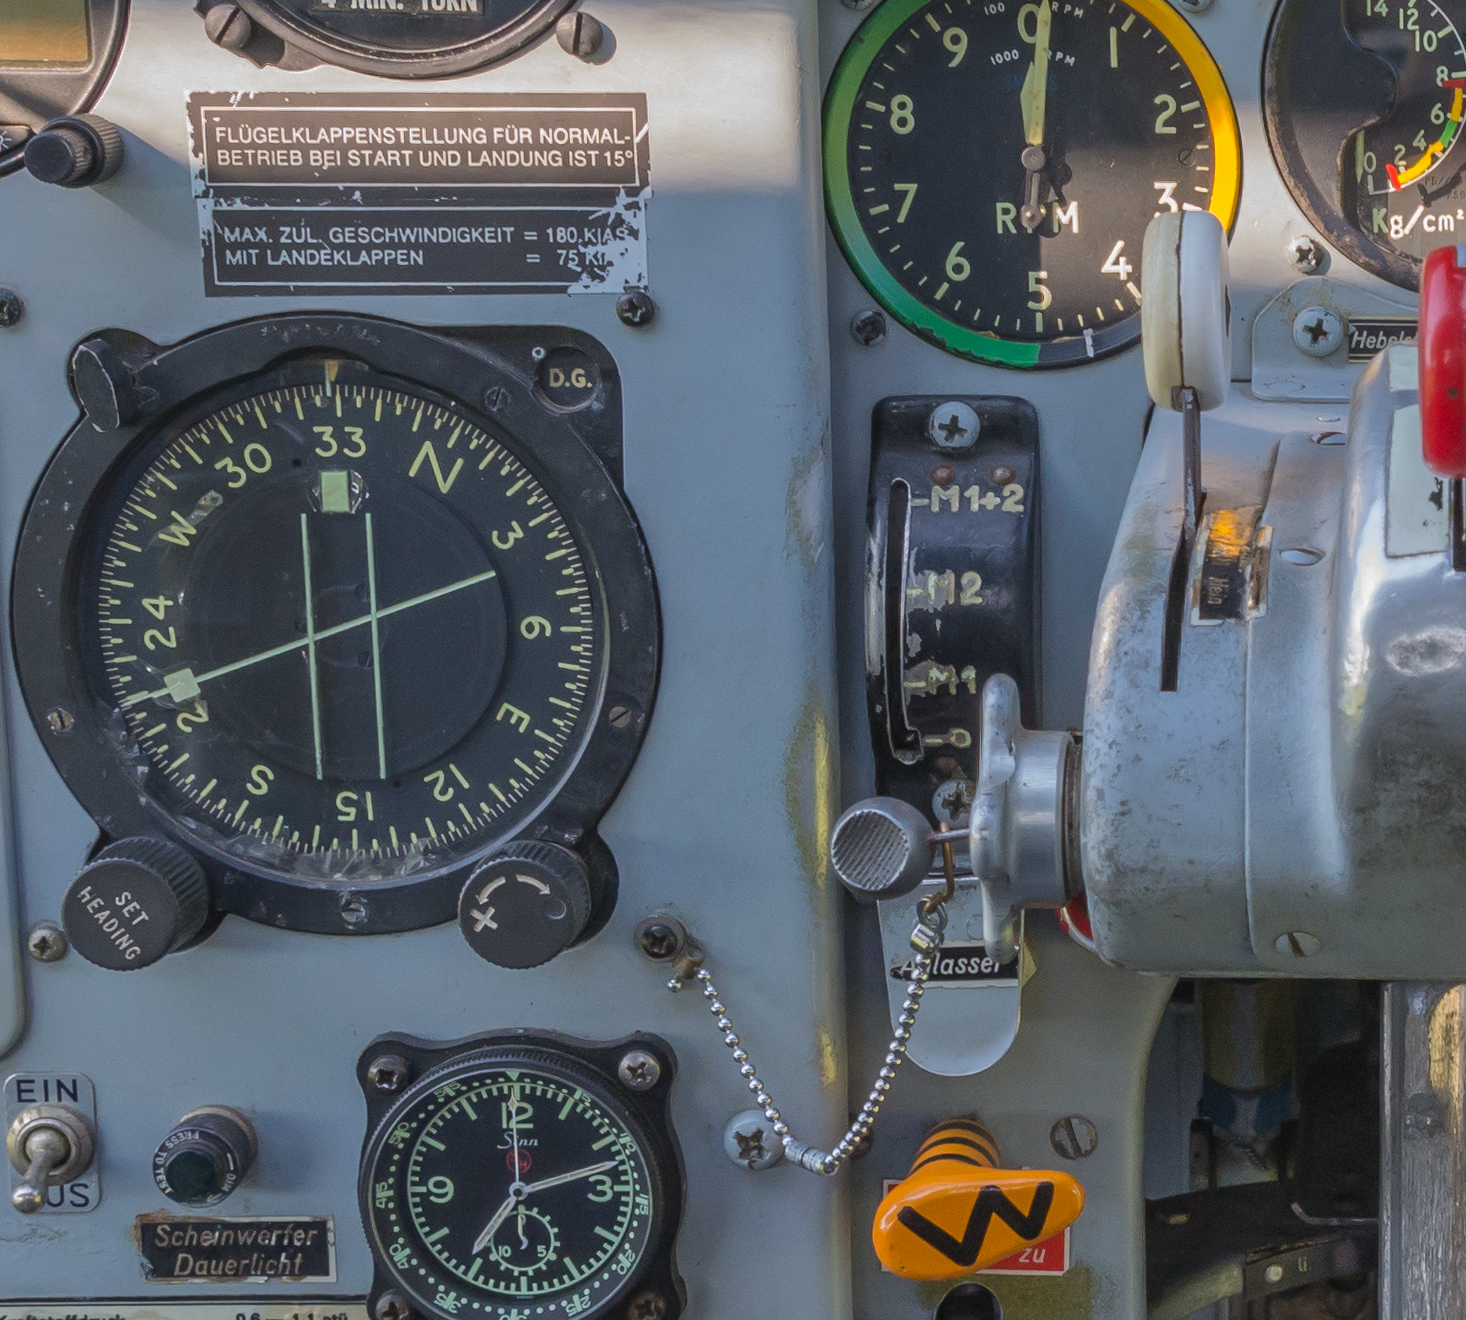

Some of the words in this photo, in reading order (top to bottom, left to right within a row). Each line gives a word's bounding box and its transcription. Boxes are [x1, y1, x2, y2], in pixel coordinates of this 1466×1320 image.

[215, 124, 487, 145] FLÜGELKLAPPENSTELLUNG
[493, 124, 533, 144] FÜR
[539, 128, 631, 145] NORMAL-
[217, 150, 303, 166] BETRIEB
[310, 150, 341, 166] BEI
[347, 150, 413, 166] START
[419, 150, 461, 167] UND
[467, 150, 563, 167] LANDUNG
[569, 150, 599, 167] IST
[604, 149, 633, 167] 15°
[226, 249, 259, 266] MIT
[267, 249, 423, 266] LANDEKLAPPEN
[548, 368, 592, 388] D.G.
[314, 426, 366, 456] 33
[408, 441, 464, 494] N
[16, 1079, 79, 1103] EIN
[155, 1225, 317, 1249] Scheinwerfer
[173, 1253, 303, 1277] Dauerlicht
